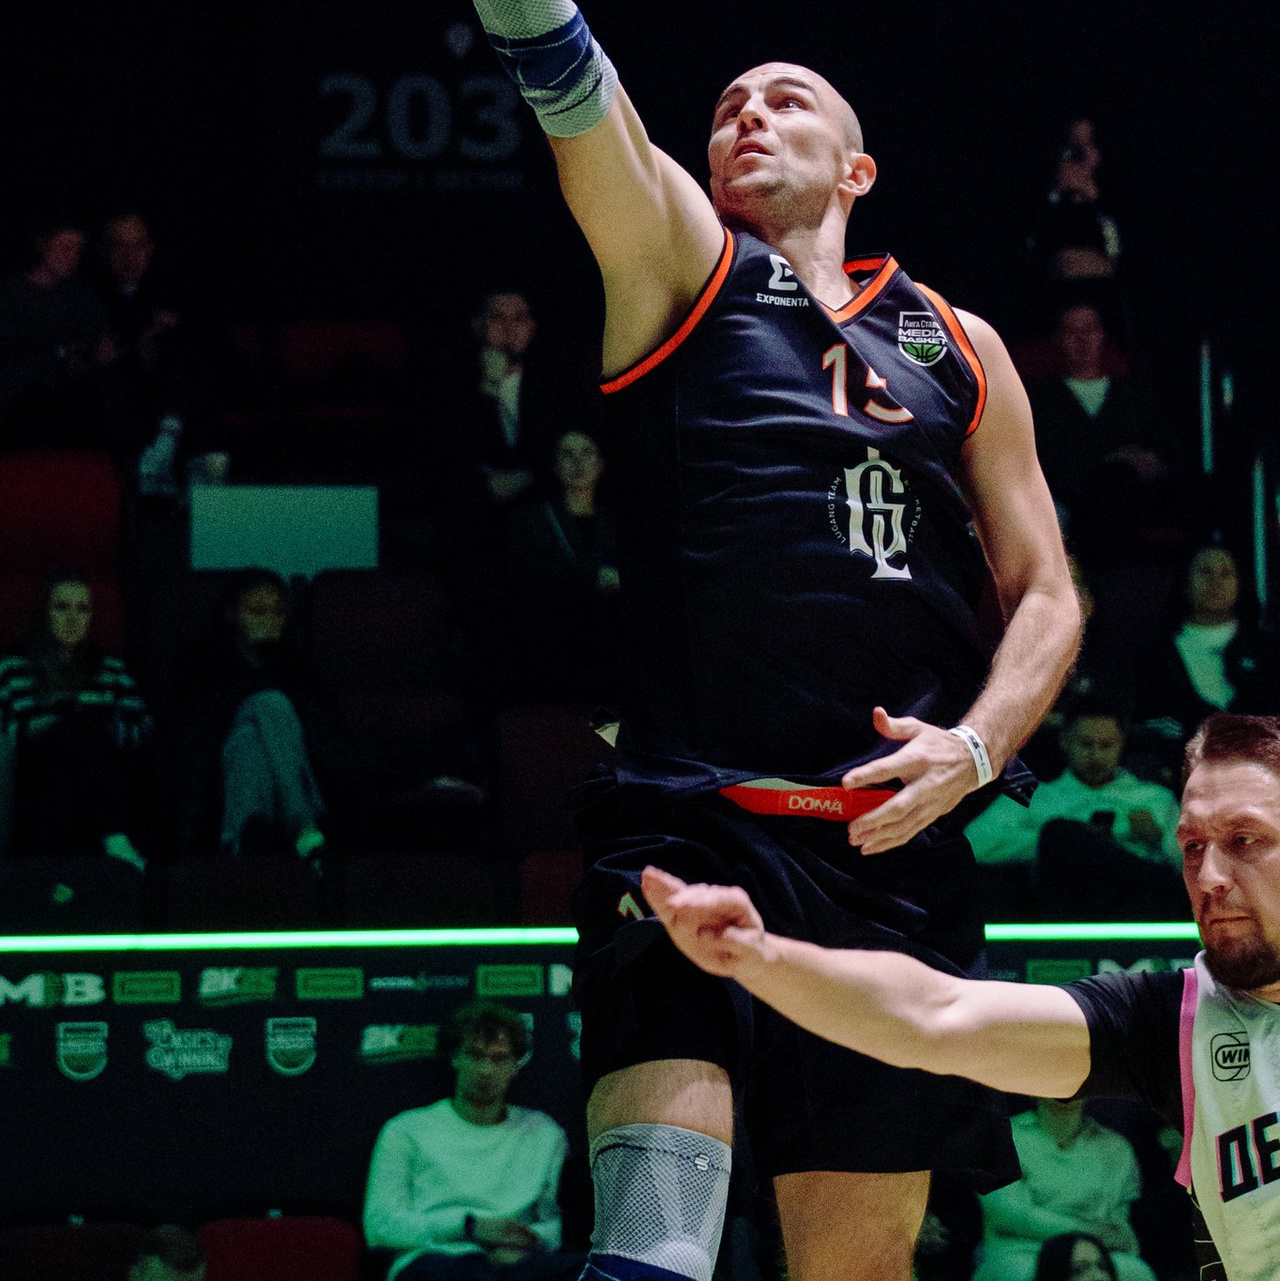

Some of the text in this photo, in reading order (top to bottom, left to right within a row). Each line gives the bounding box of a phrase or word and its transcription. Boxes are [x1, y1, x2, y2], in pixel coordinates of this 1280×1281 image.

[318, 74, 522, 159] 203
[756, 292, 810, 308] EXPONENTA
[898, 328, 947, 339] MEDIA
[898, 335, 948, 345] BASKET
[828, 476, 842, 500] TEAM
[827, 502, 847, 544] LUGANG
